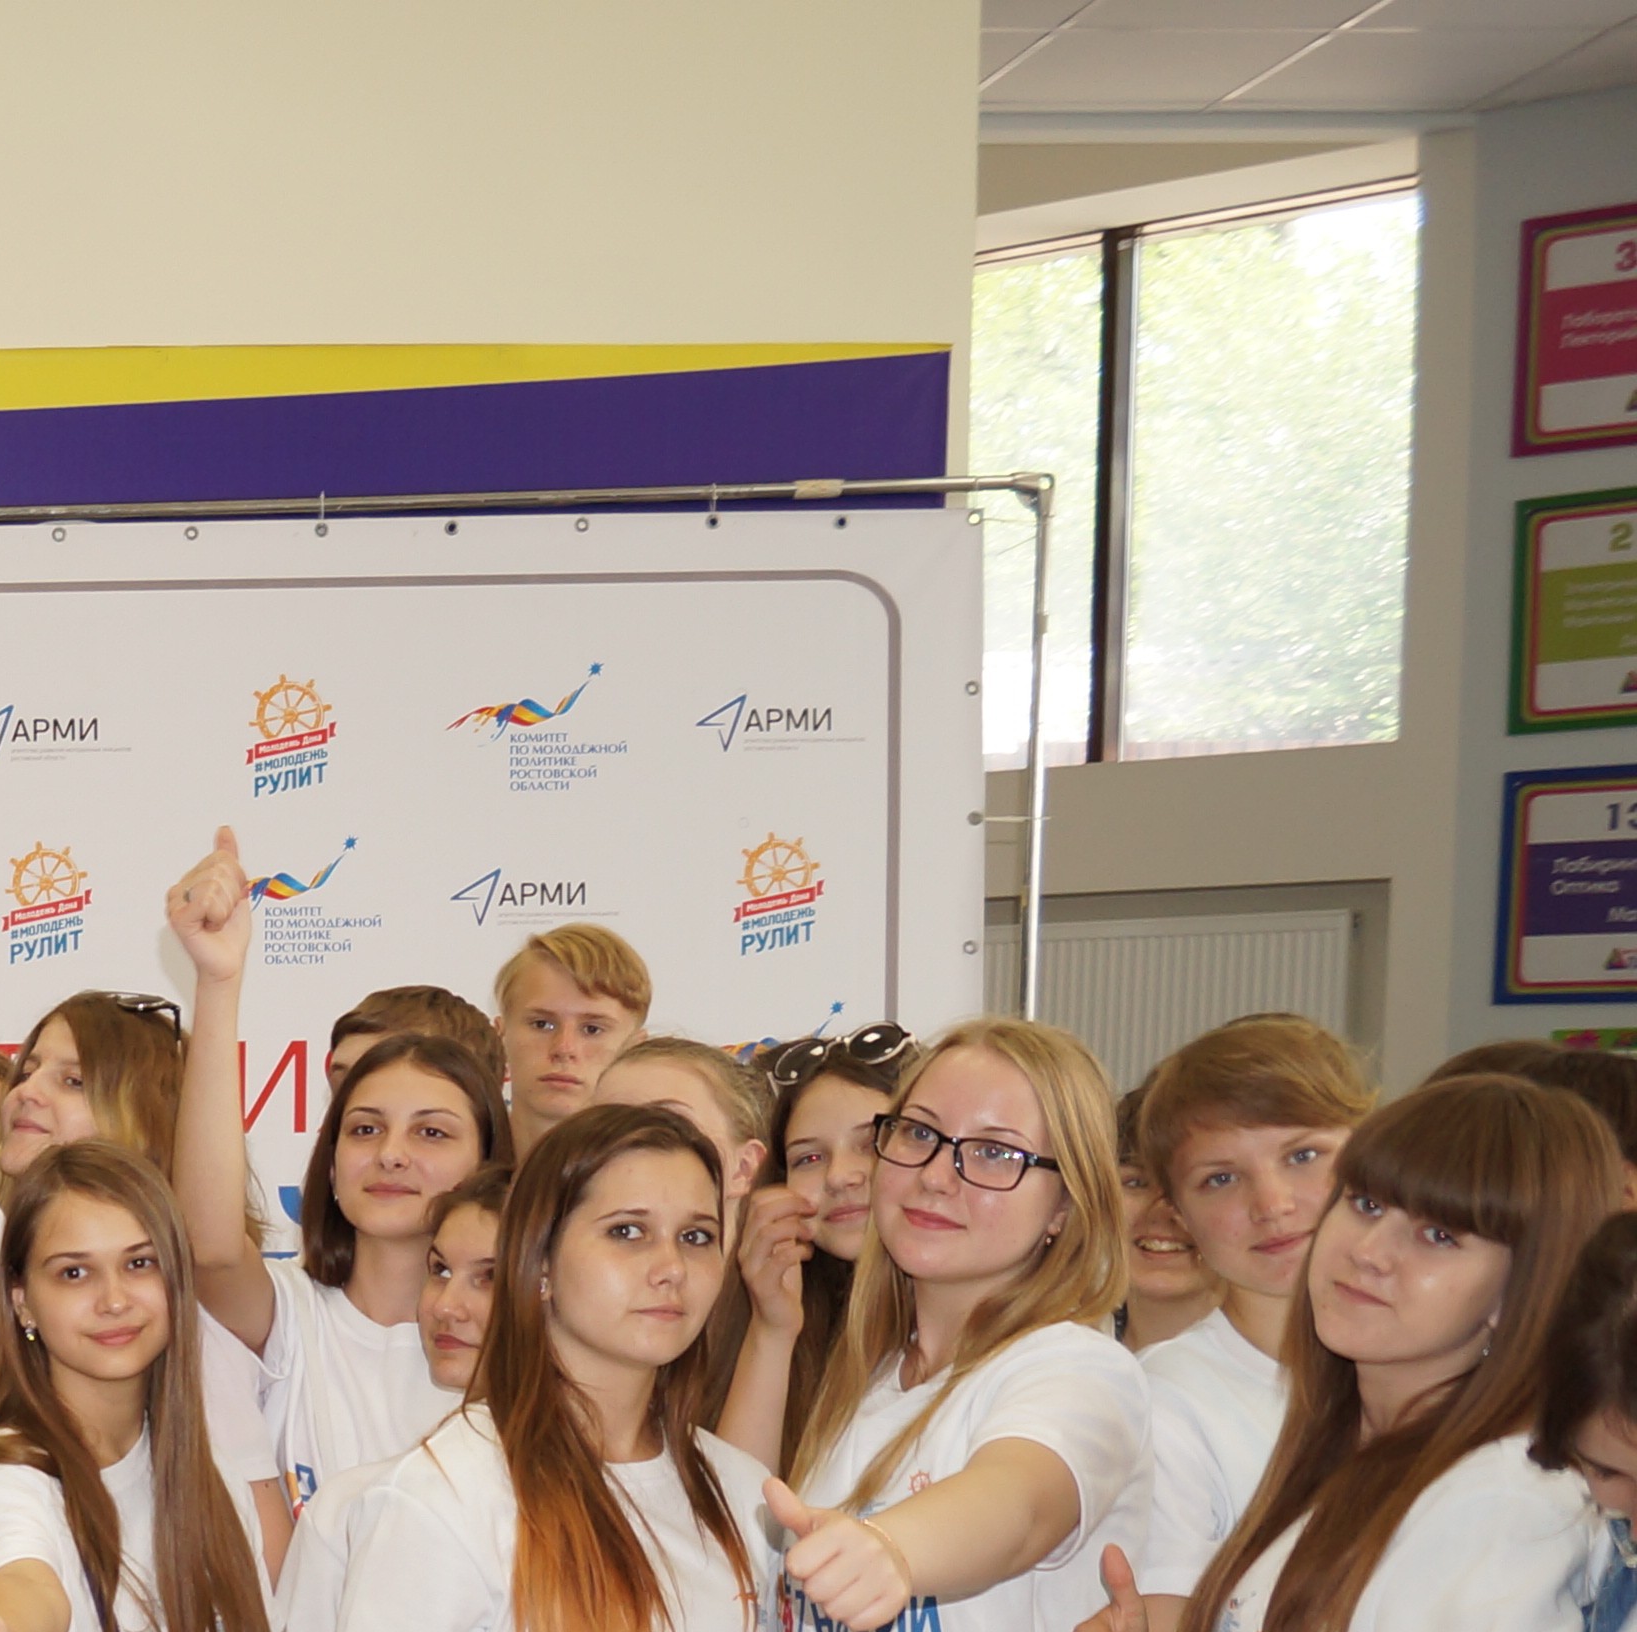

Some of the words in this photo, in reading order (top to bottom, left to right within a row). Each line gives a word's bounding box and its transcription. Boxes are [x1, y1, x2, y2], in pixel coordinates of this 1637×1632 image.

[744, 707, 832, 732] АРМИ
[11, 717, 98, 742] АРМИ
[510, 732, 569, 743] КОМИТЕТ
[510, 744, 530, 755] ПО
[510, 756, 577, 767] ПОЛИТИКЕ
[510, 765, 597, 779] РОСТОВСКОЙ
[254, 761, 328, 798] РУЛИТ
[510, 781, 570, 791] ОБЛАСТИ
[498, 881, 586, 907] АРМИ
[264, 906, 322, 917] КОМИТЕТ
[264, 918, 284, 928] ПО
[264, 930, 332, 940] ПОЛИТИКЕ
[741, 920, 816, 956] РУЛИТ
[9, 929, 83, 964] РУЛИТ
[264, 939, 351, 953] РОСТОВСКОЙ
[264, 954, 325, 965] ОБЛАСТИ
